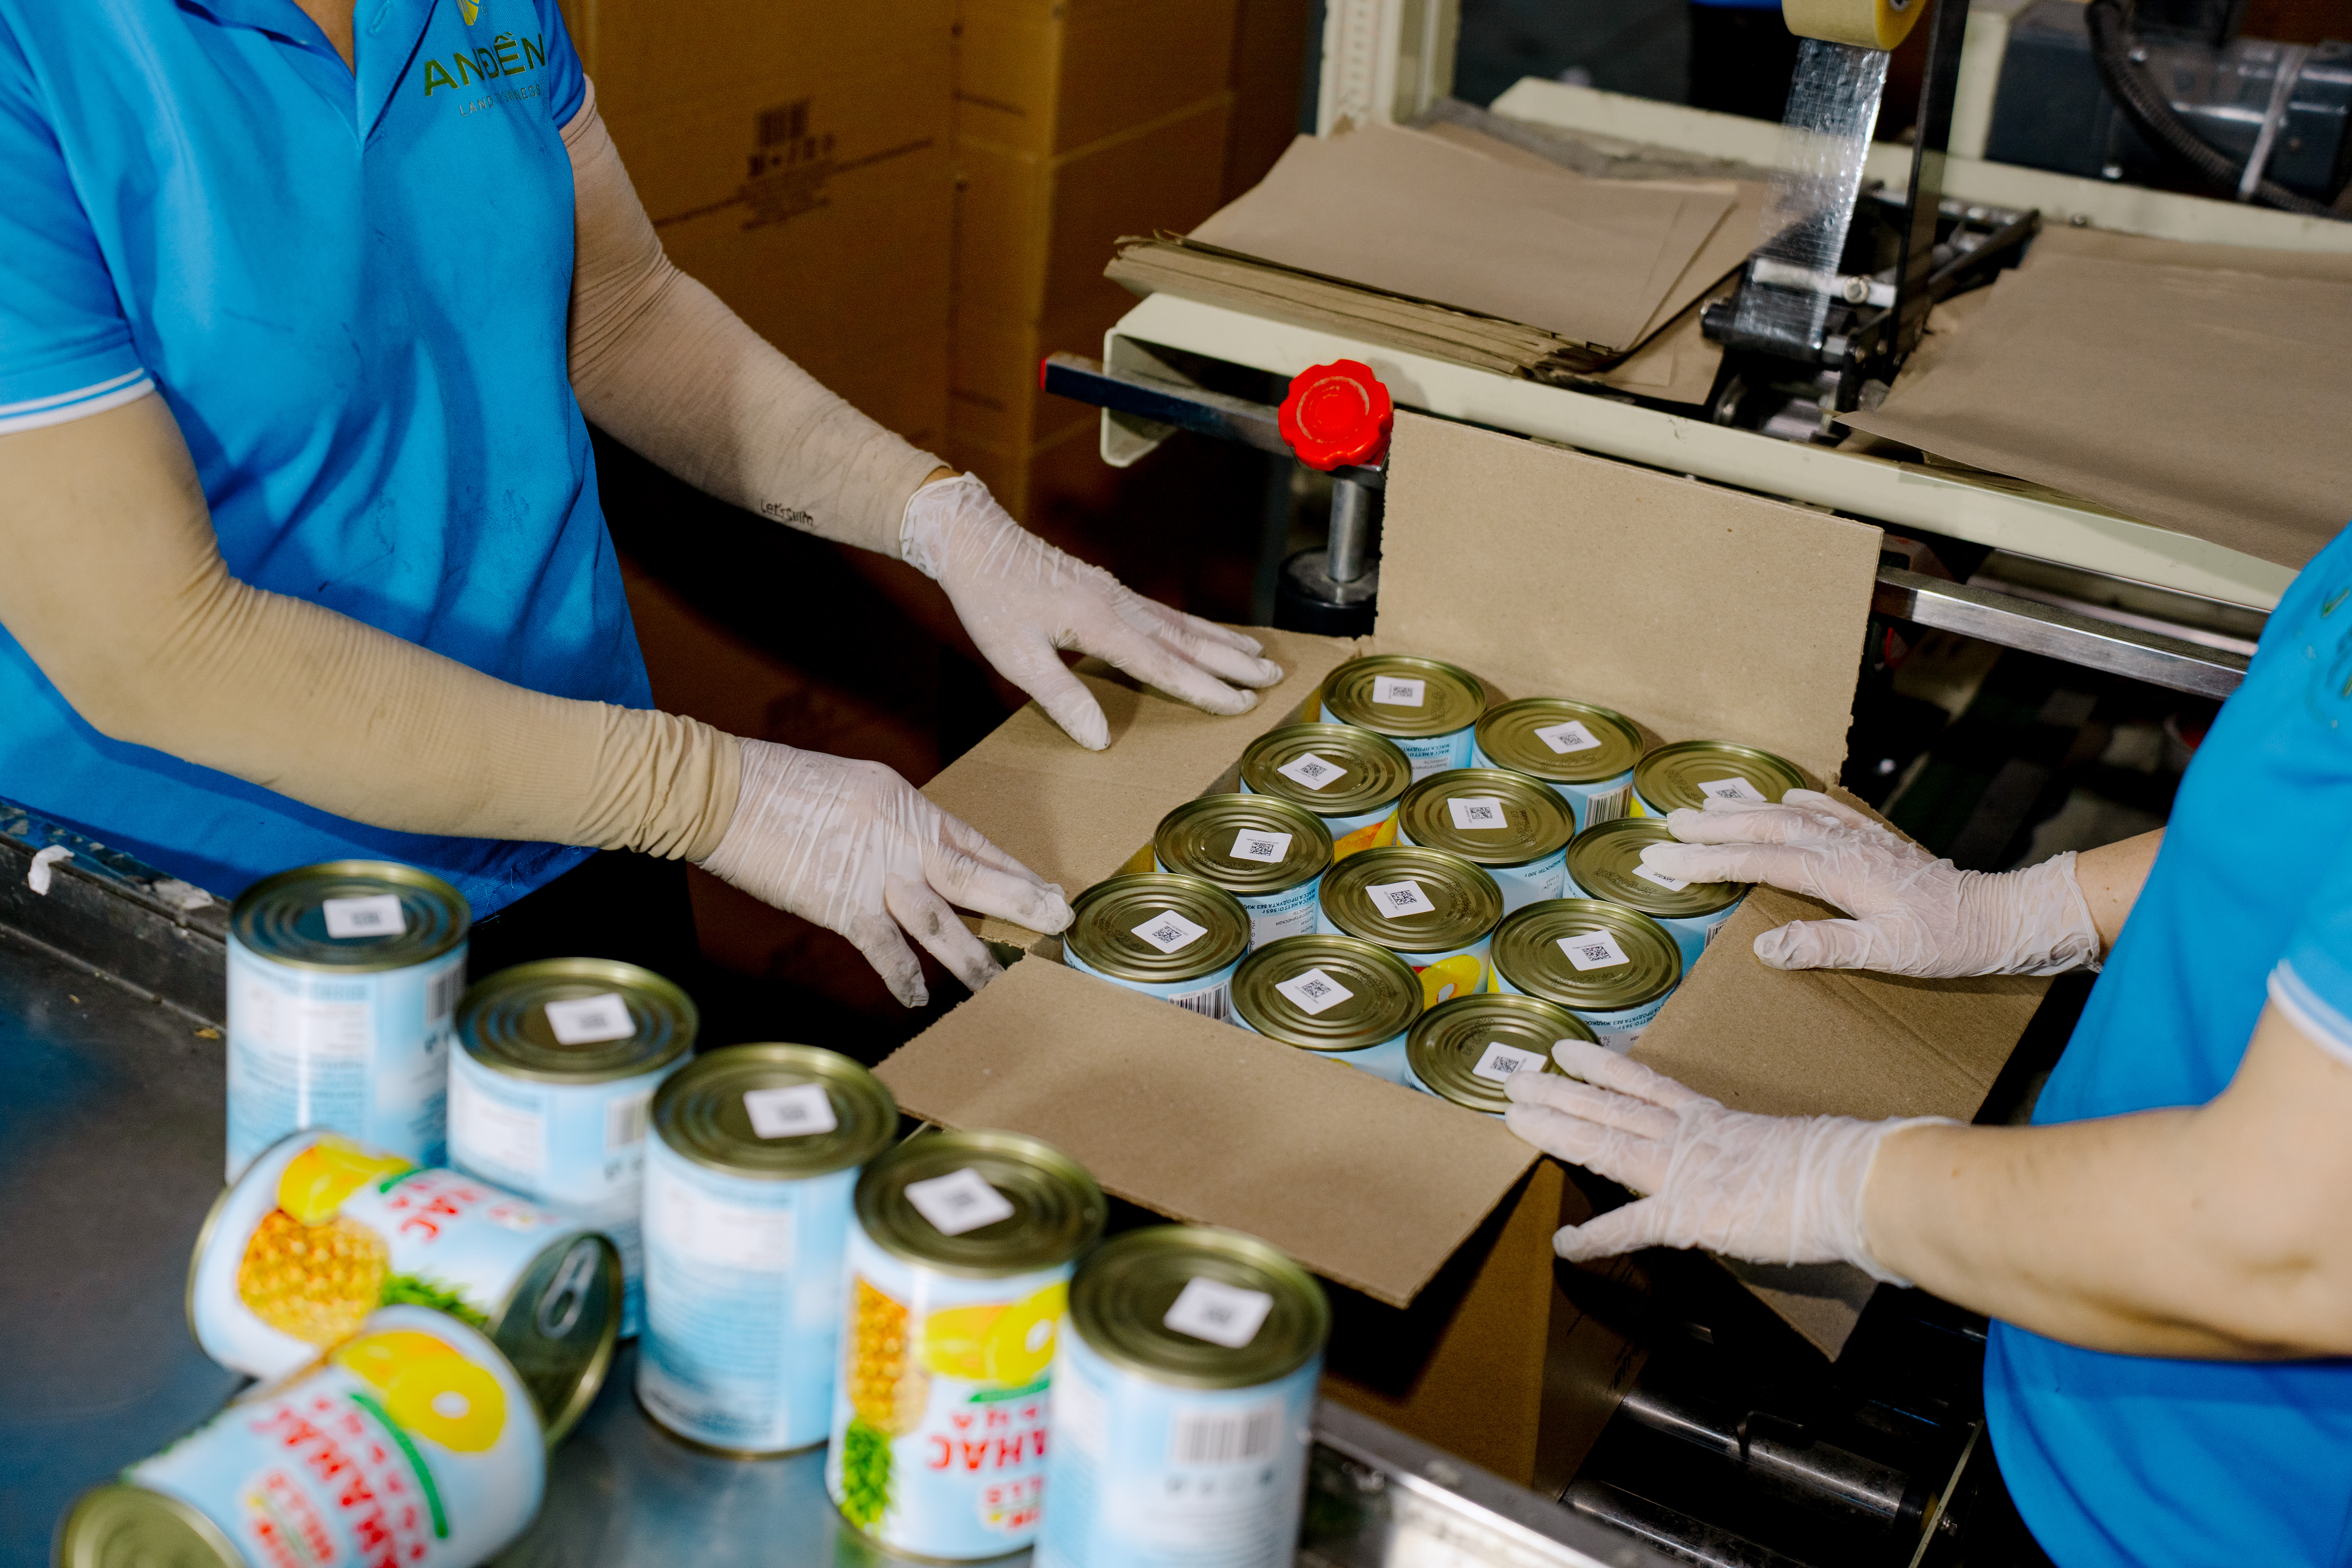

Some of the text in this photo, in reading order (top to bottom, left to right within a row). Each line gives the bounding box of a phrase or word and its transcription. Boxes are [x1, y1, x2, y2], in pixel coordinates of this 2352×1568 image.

[459, 96, 494, 116] LAND
[1299, 888, 1315, 899] МАССА
[1299, 893, 1315, 905] МАССА
[1269, 896, 1299, 907] ПРОДУКТА
[1292, 902, 1315, 915] ценность
[1275, 907, 1314, 926] Энергетическая
[1301, 915, 1314, 926] Белки
[1300, 923, 1314, 933] Жиры
[1625, 1010, 1654, 1023] ПРОДУКТА
